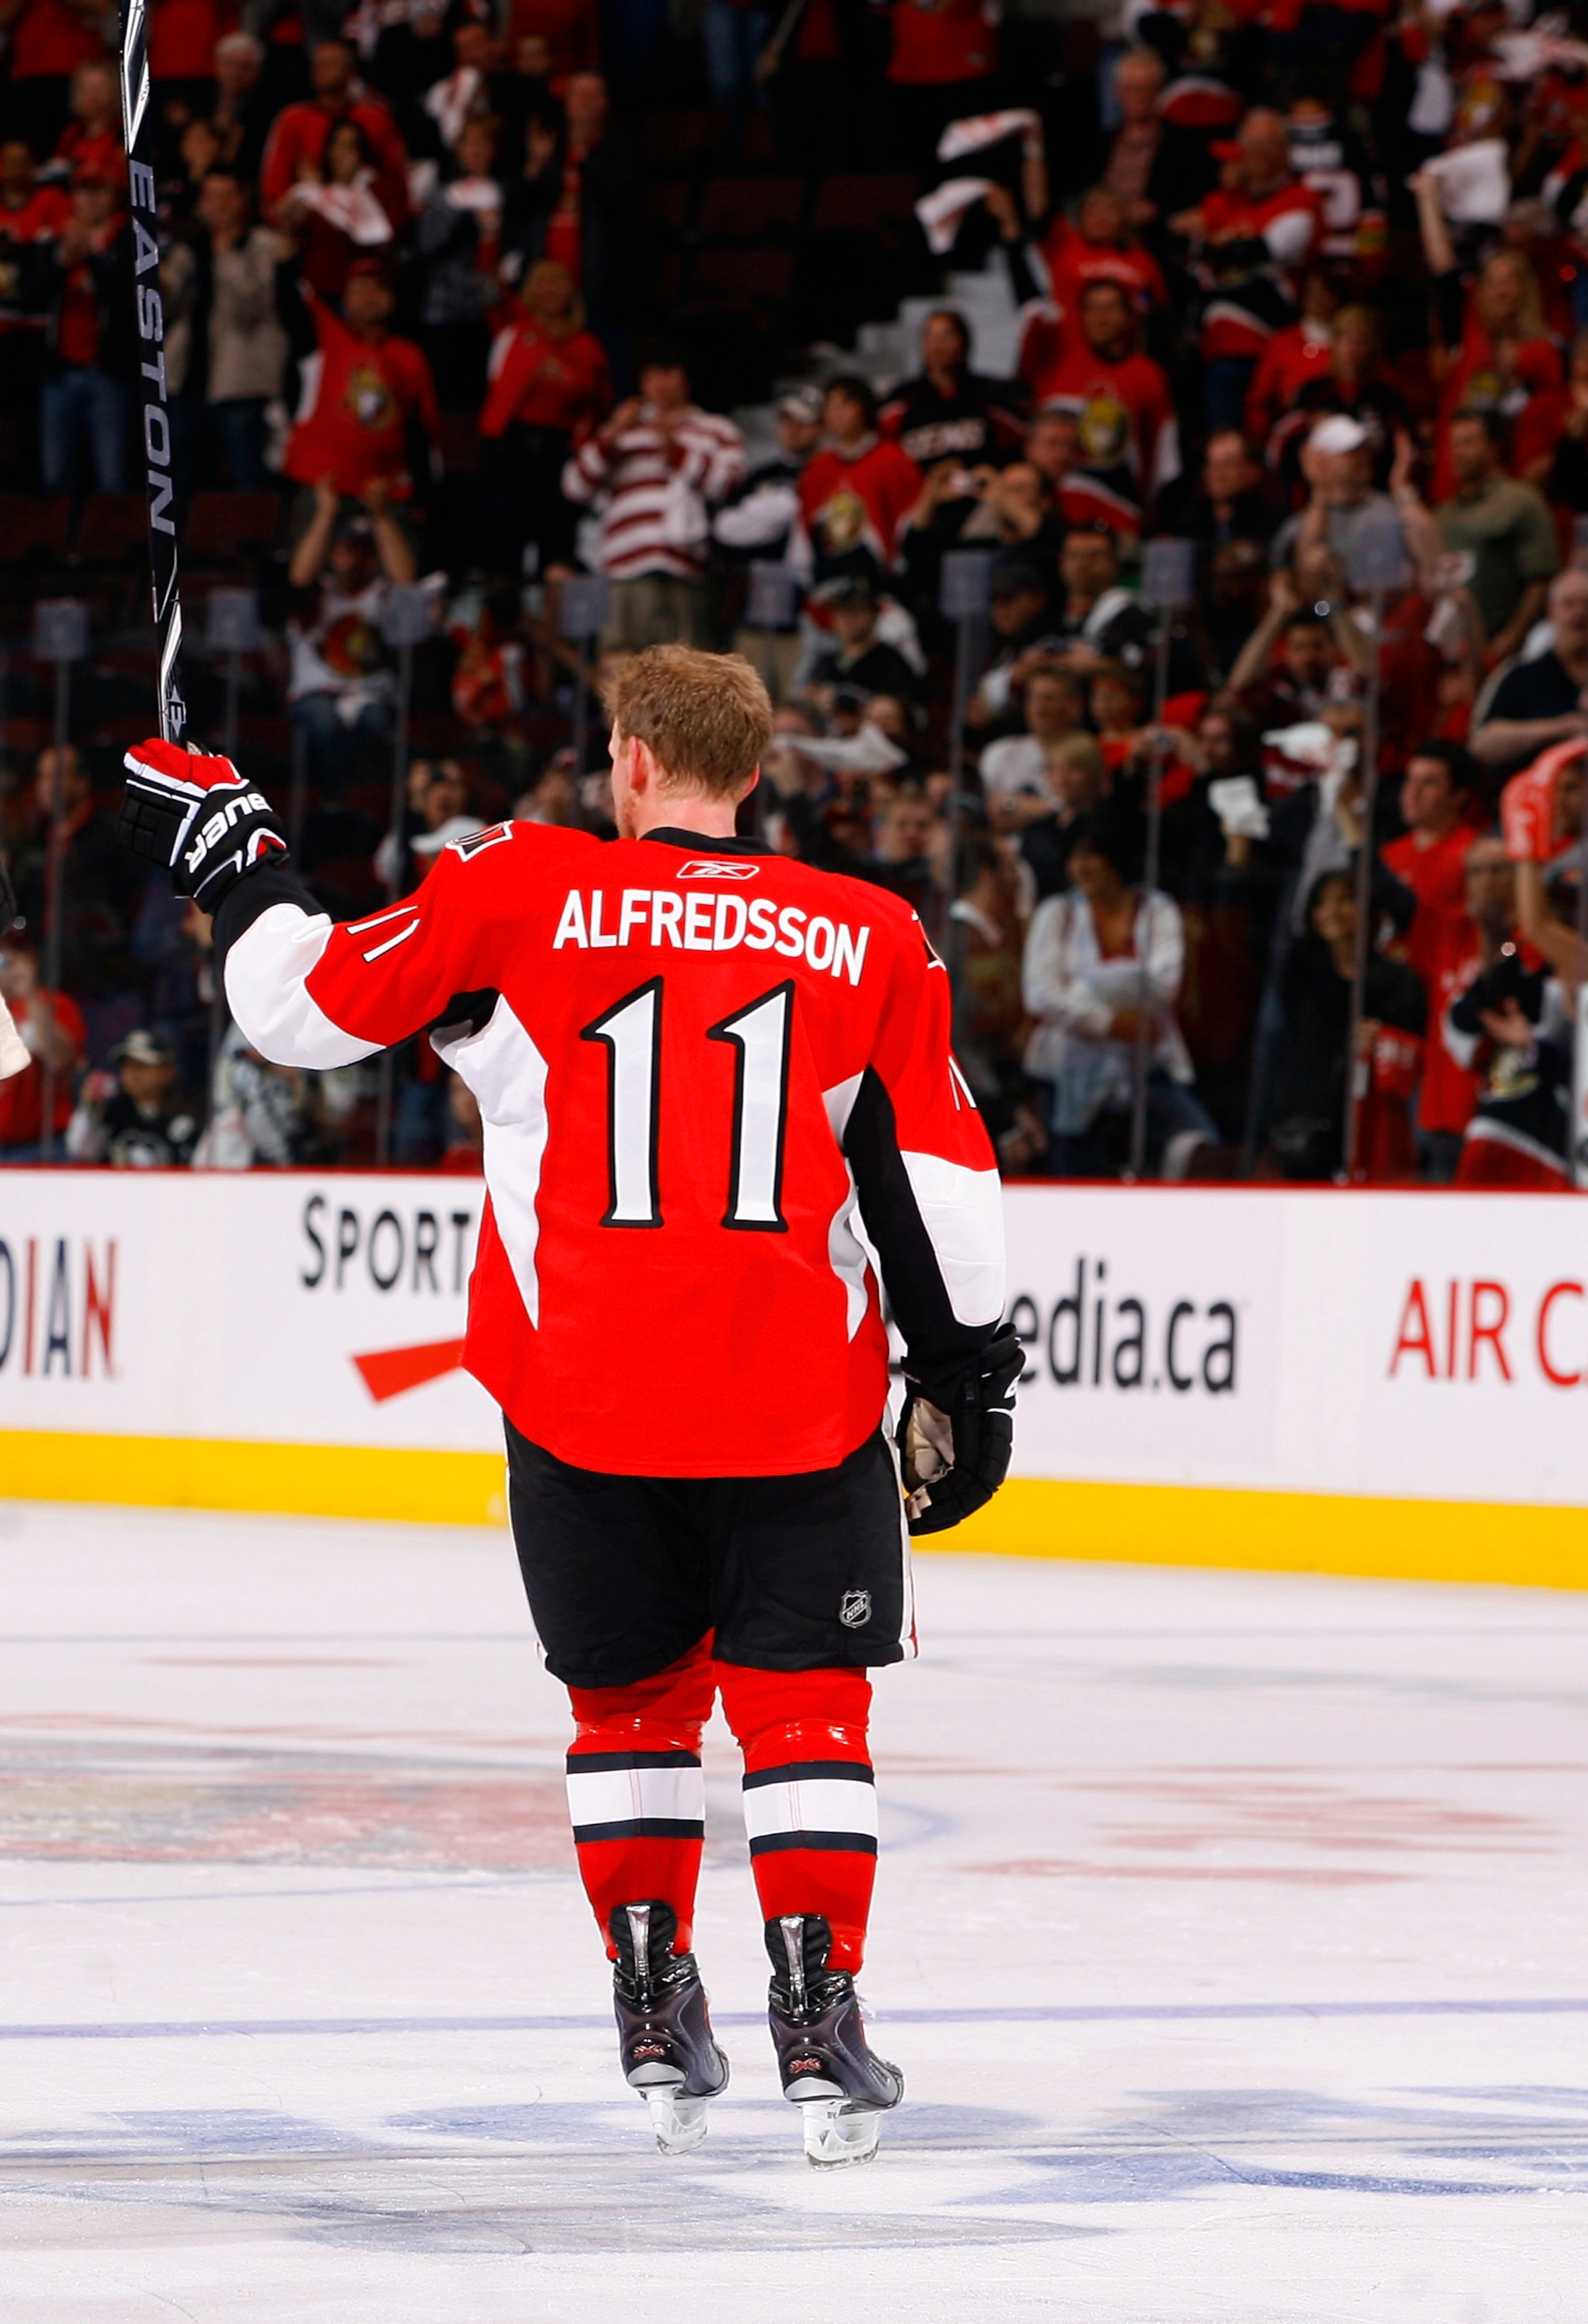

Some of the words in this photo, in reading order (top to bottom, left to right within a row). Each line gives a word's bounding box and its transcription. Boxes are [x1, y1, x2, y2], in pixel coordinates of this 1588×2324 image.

[128, 159, 175, 536] EASTON
[552, 888, 870, 986] ALFREDSSON
[579, 974, 796, 1234] 11
[1387, 1277, 1514, 1382] AIR
[1536, 1279, 1588, 1388] C
